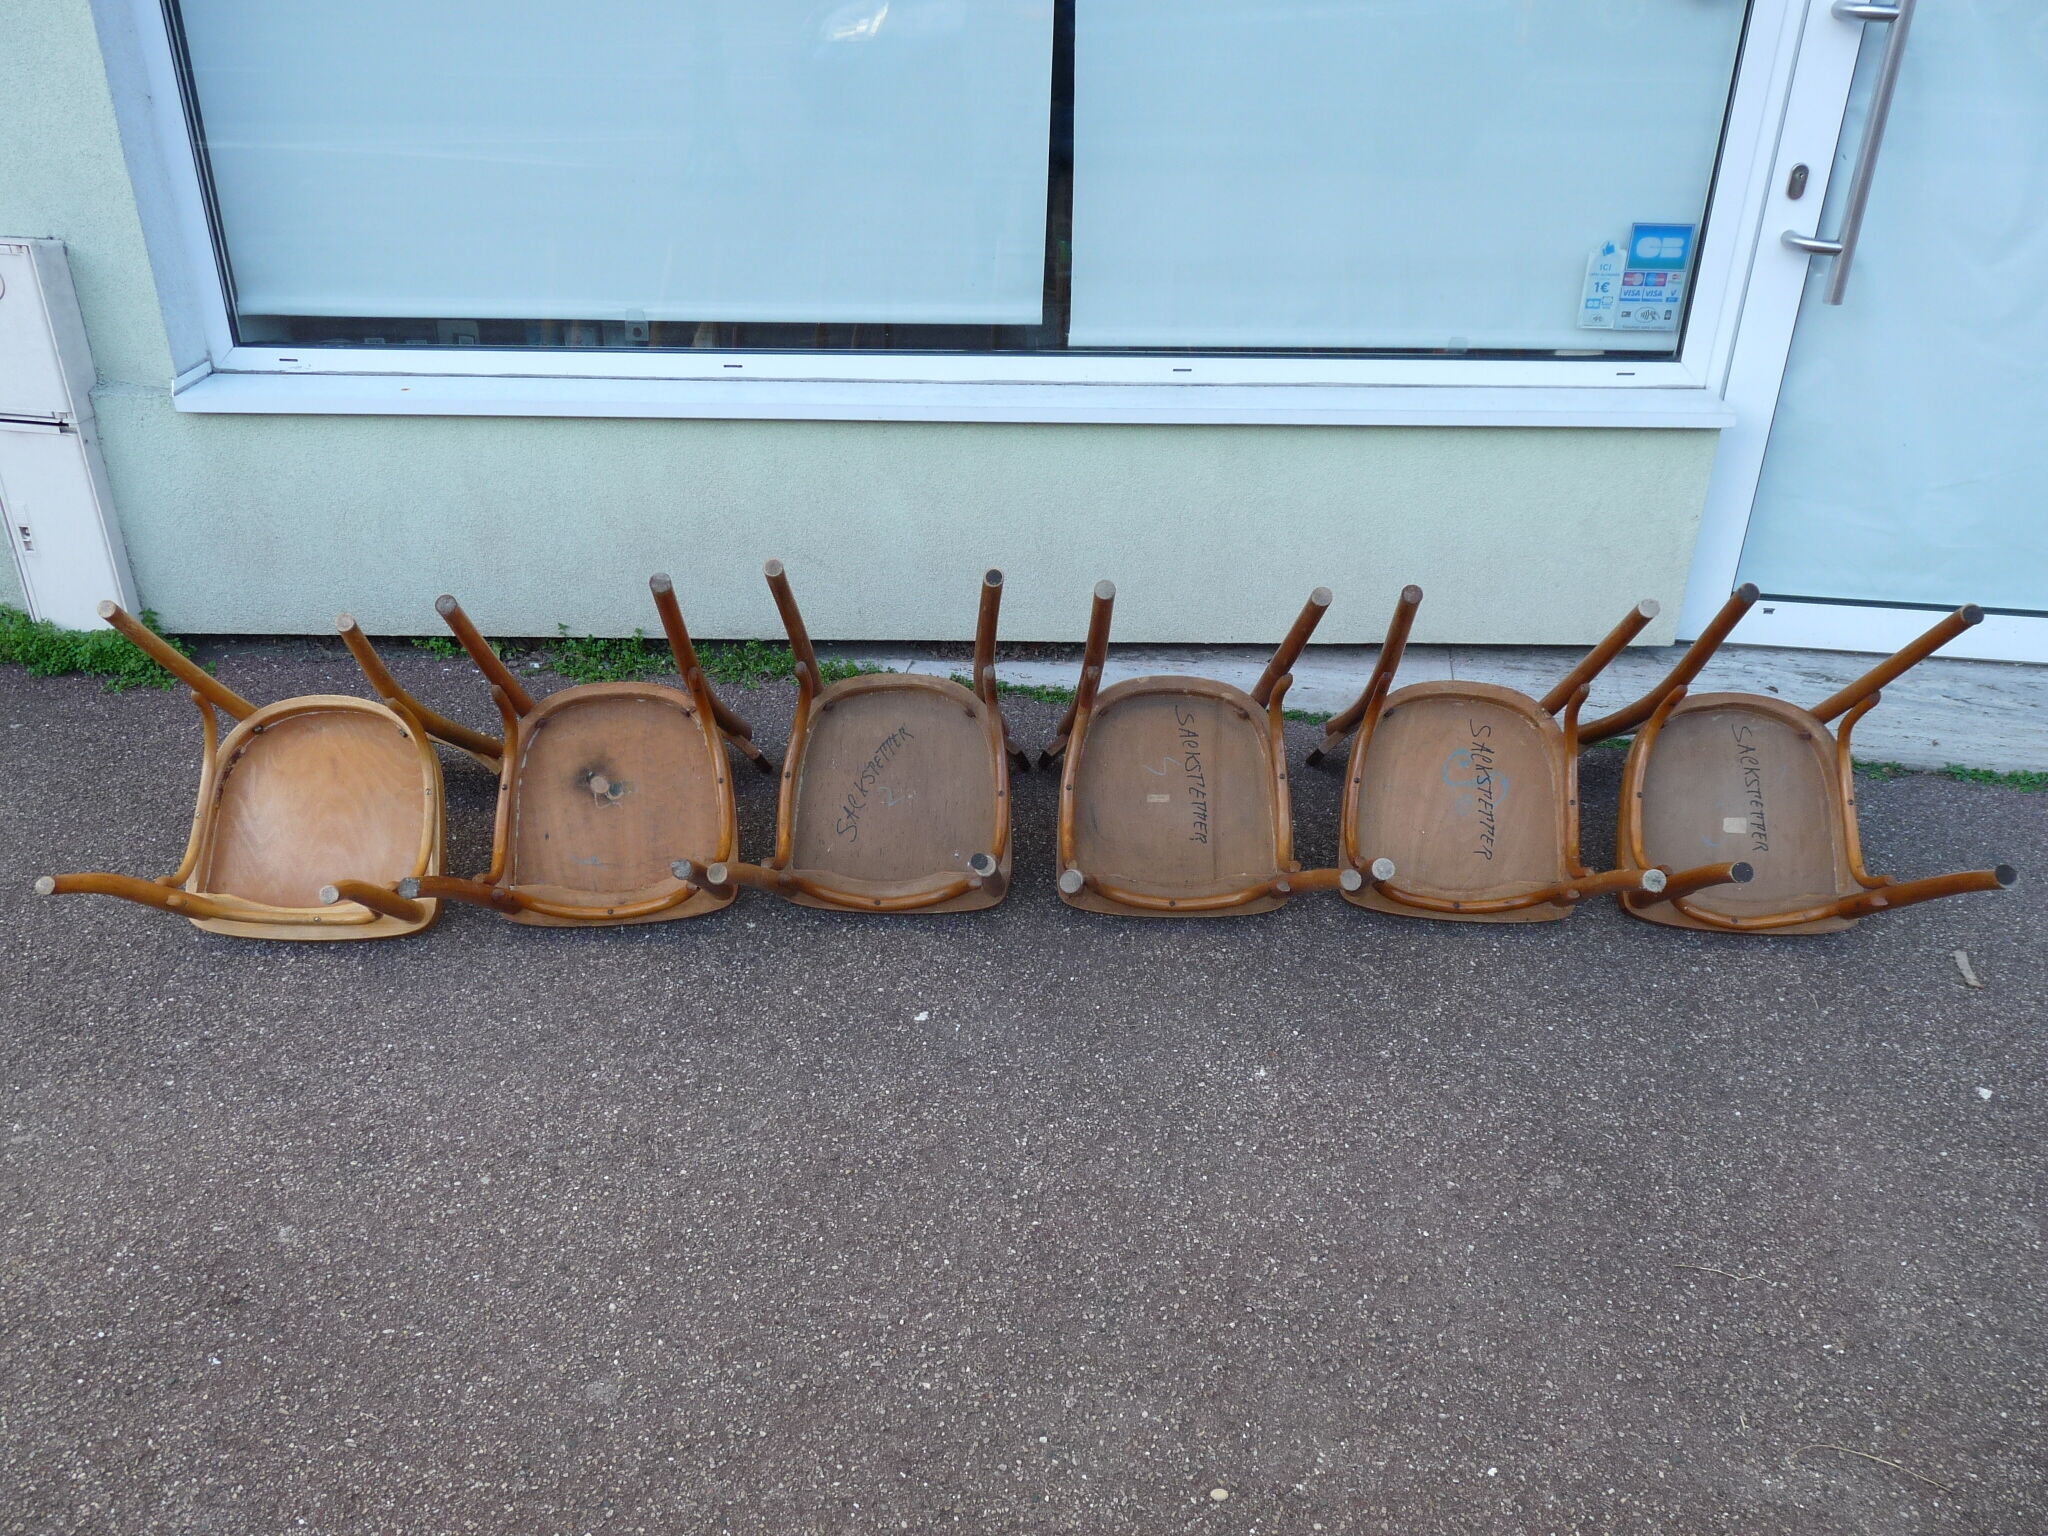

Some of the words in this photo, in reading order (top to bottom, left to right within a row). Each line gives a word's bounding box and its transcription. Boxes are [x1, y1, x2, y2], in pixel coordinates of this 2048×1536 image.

[1636, 236, 1685, 258] CB
[1594, 282, 1610, 293] 1€
[1623, 289, 1641, 297] VISA
[1645, 289, 1663, 297] VISA
